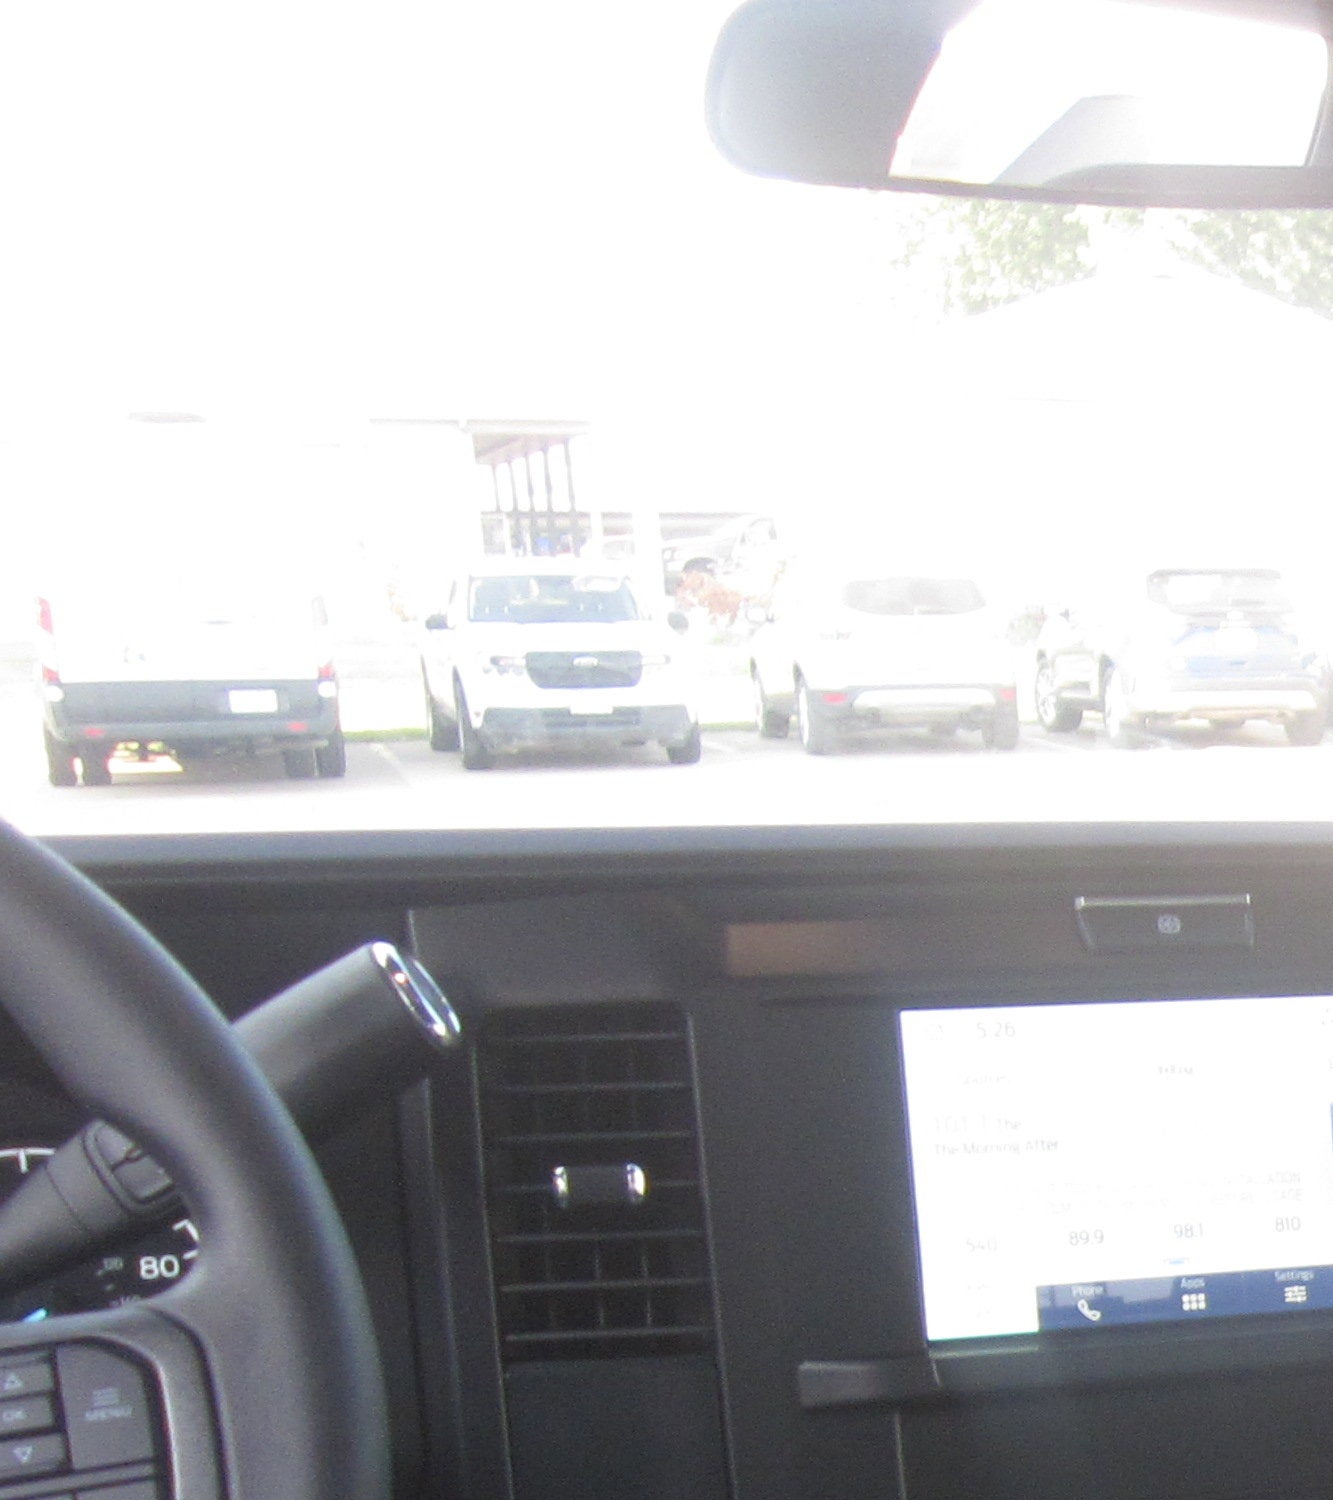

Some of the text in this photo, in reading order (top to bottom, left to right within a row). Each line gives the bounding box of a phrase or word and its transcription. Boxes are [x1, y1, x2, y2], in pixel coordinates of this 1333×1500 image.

[1025, 1138, 1059, 1152] After
[1068, 1229, 1104, 1246] 89.9
[1173, 1222, 1203, 1239] 98.1
[1275, 1216, 1302, 1232] 810
[140, 1254, 180, 1279] 80
[1180, 1278, 1204, 1290] Apps
[1275, 1271, 1314, 1282] Settings
